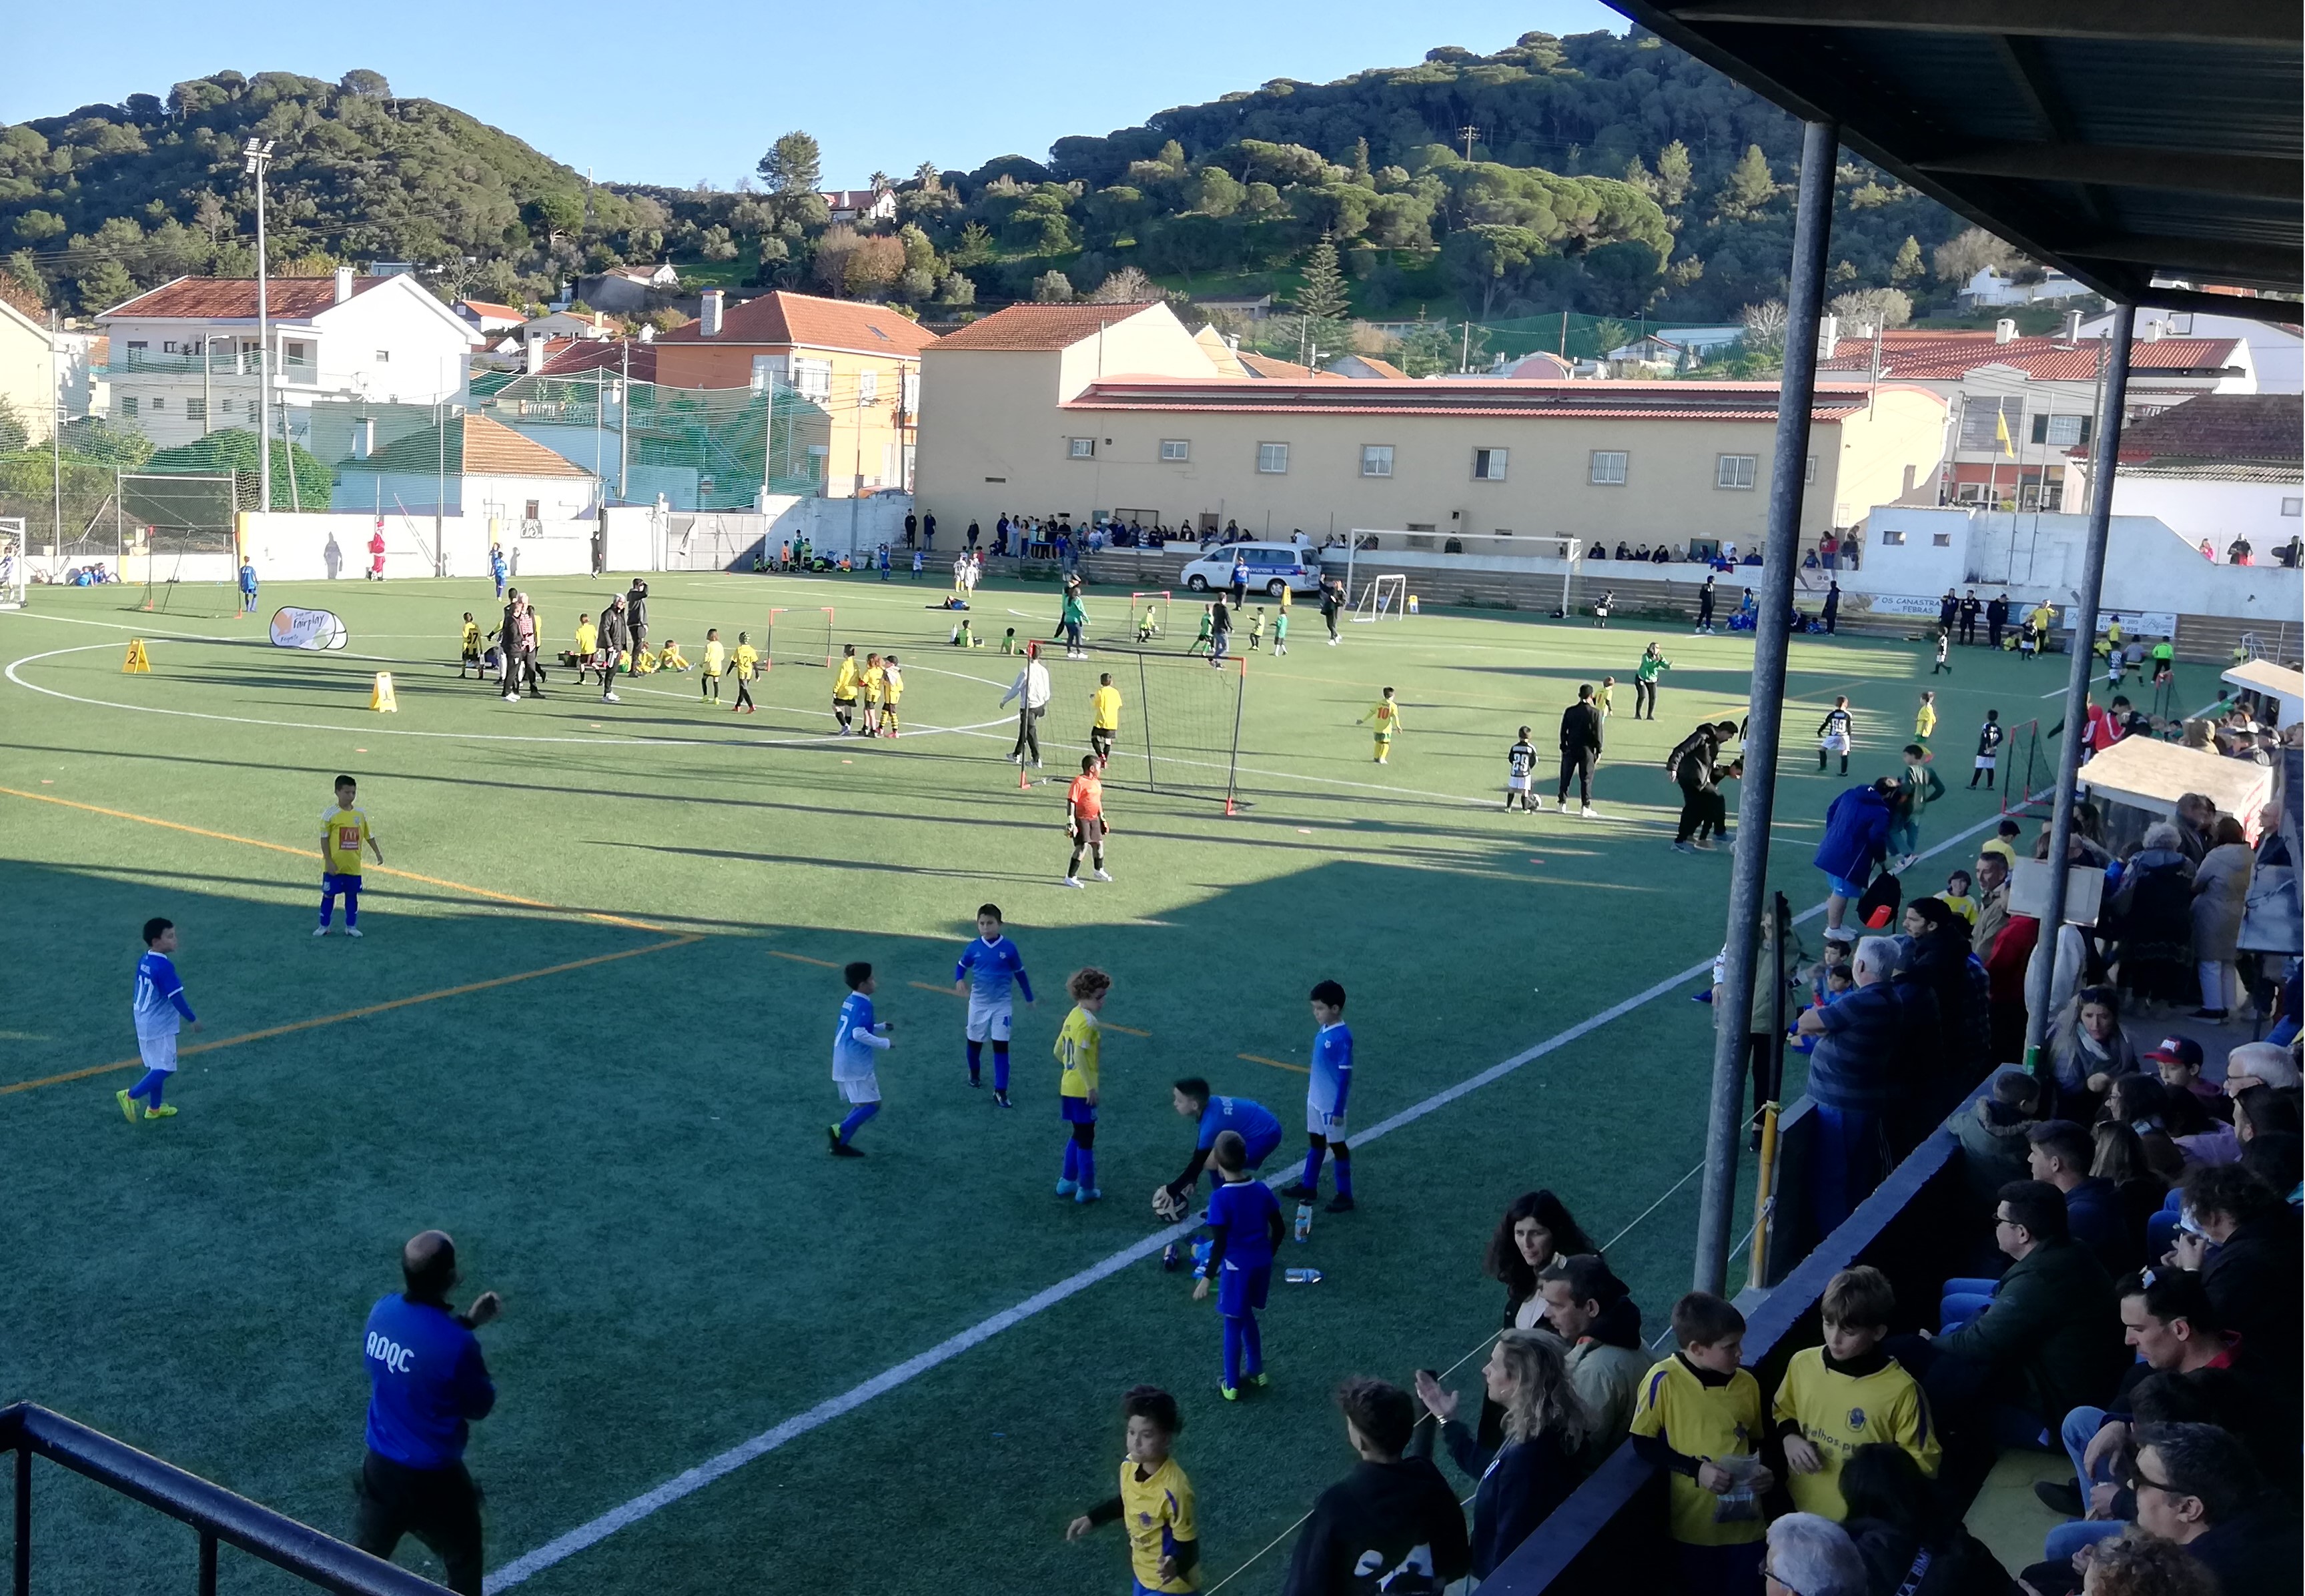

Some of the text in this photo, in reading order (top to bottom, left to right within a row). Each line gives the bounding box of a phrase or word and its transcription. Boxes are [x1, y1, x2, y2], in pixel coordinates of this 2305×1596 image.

[1896, 598, 1941, 606] CANASTRA
[1902, 606, 1933, 614] FEBRAS
[294, 614, 325, 631] Fairplay
[127, 651, 136, 664] 2
[382, 688, 391, 701] 1
[1378, 707, 1389, 719] 10
[1512, 754, 1528, 772] 29
[134, 975, 154, 1012] 17
[366, 1331, 414, 1374] ADQC
